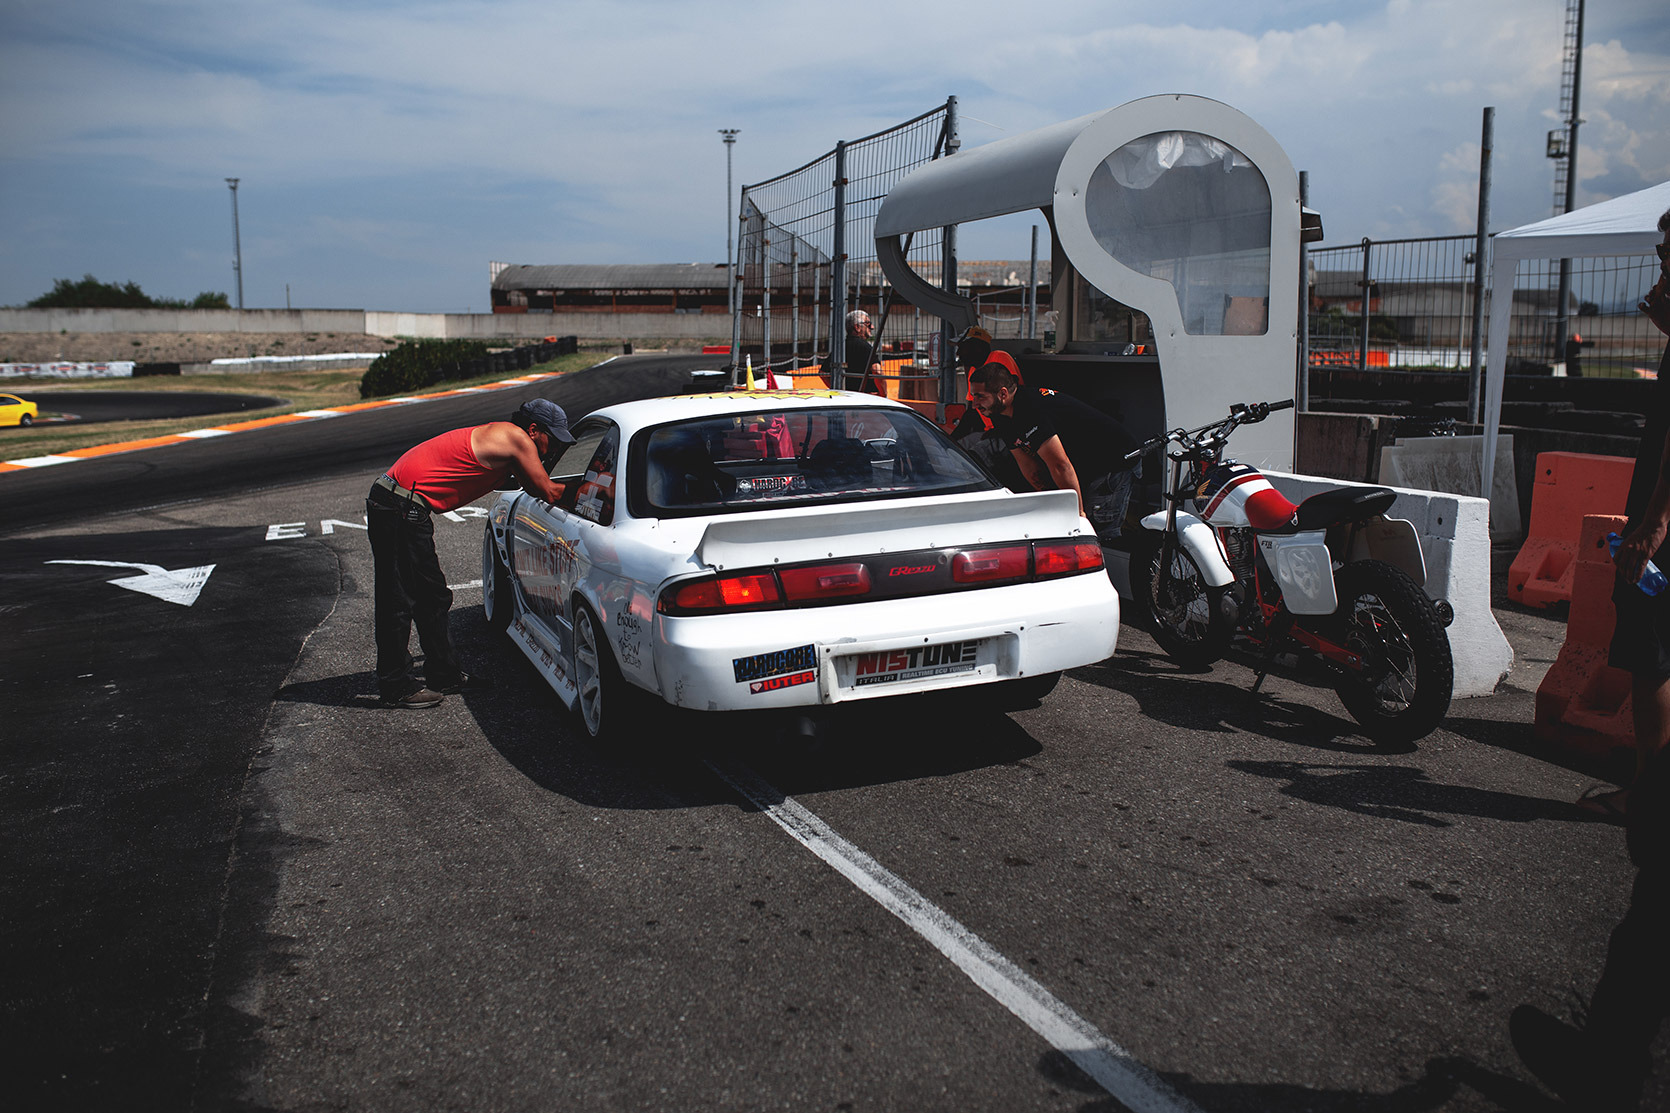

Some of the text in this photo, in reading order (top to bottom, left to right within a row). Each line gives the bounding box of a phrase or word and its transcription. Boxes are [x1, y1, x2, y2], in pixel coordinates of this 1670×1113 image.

[902, 669, 934, 679] REALTIME
[949, 665, 974, 673] TUNING
[764, 672, 815, 691] IUTER
